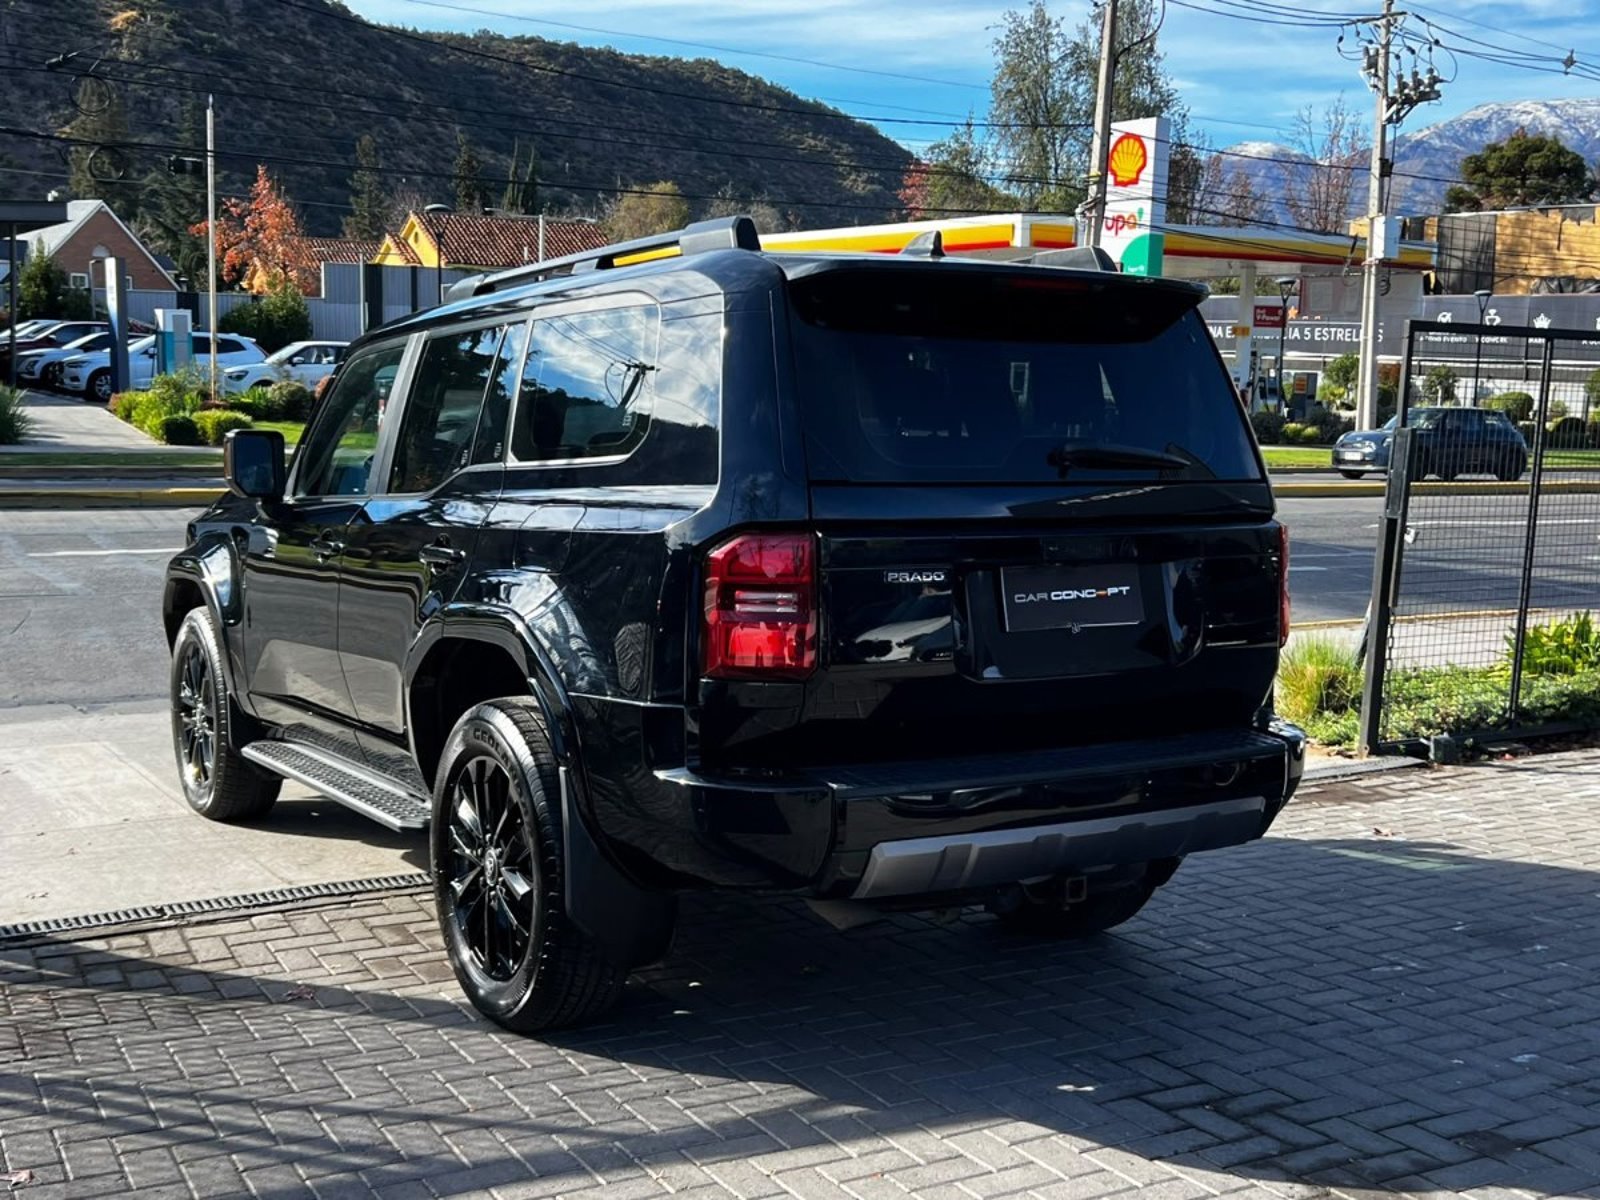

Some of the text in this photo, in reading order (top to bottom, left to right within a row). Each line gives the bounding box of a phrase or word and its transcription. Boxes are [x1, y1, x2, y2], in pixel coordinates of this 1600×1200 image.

[1207, 326, 1224, 338] NA
[1304, 327, 1311, 341] 5
[1314, 327, 1384, 343] ESTRELS
[887, 571, 945, 582] PRADO
[1014, 593, 1049, 603] CAR
